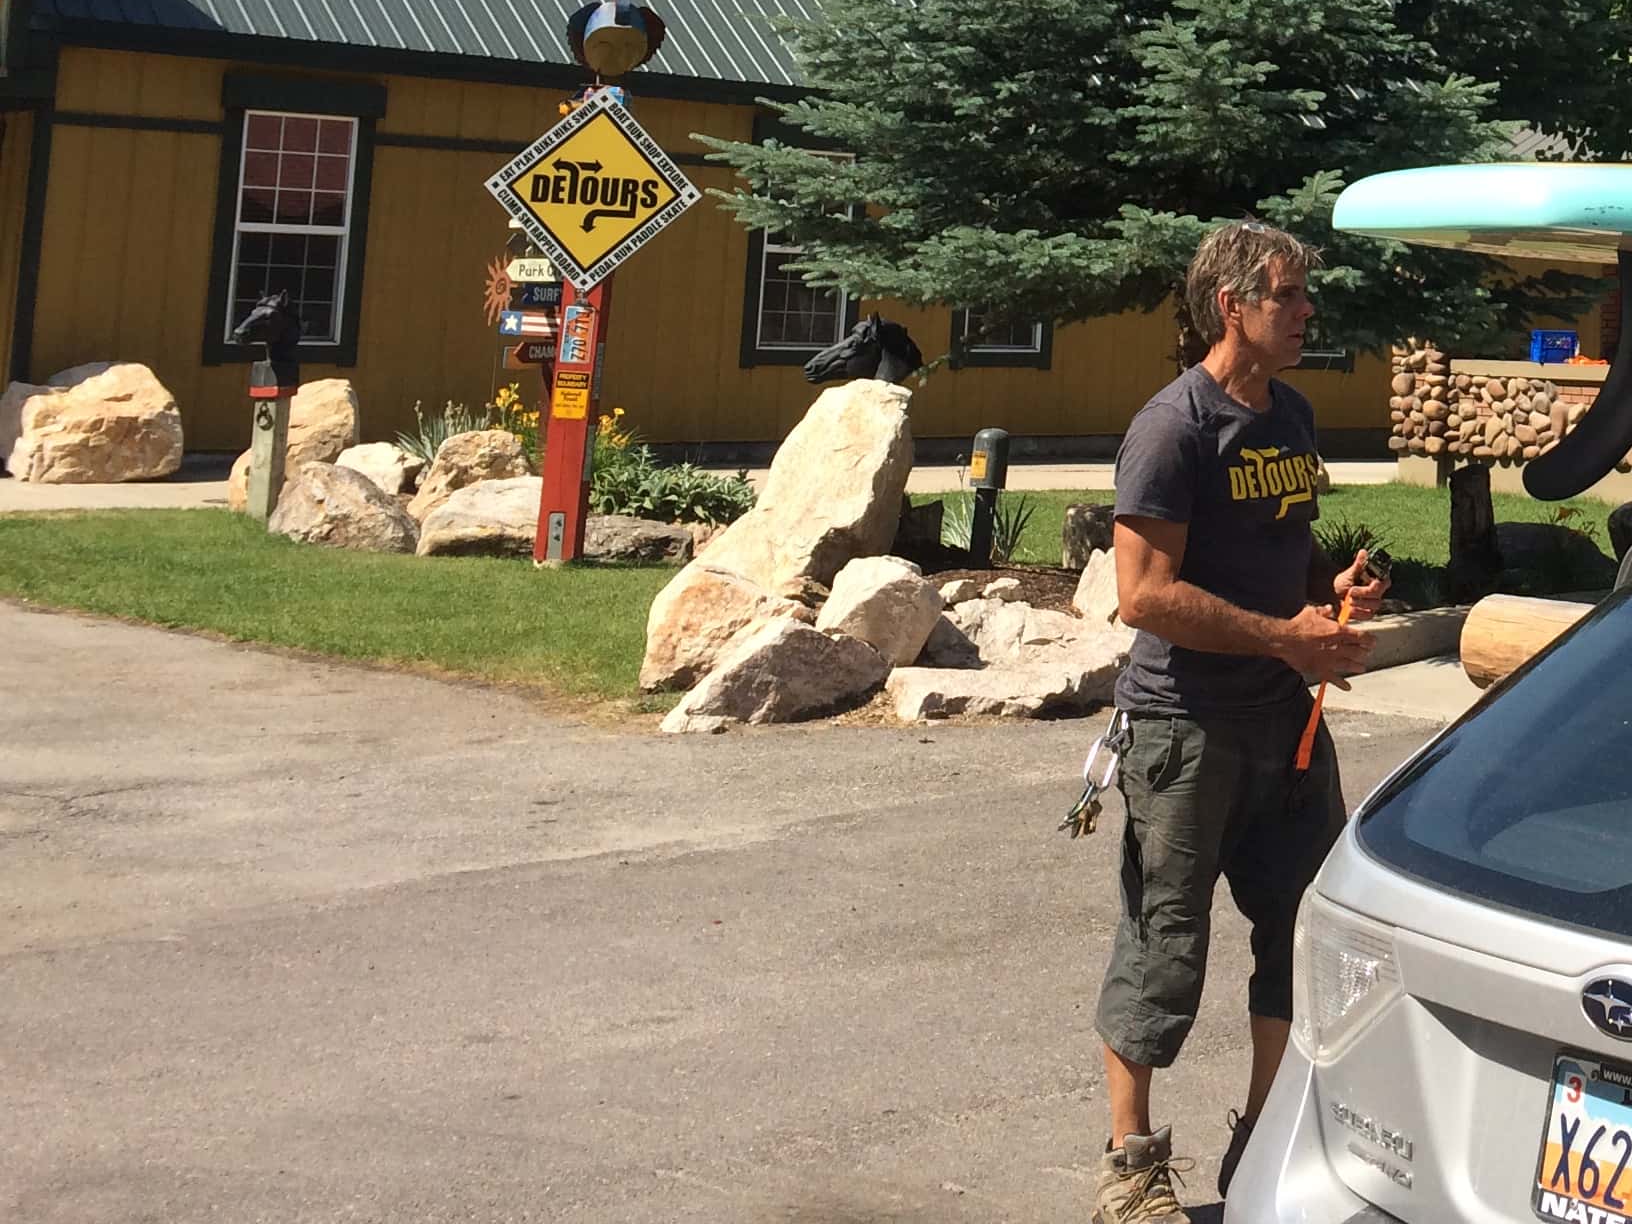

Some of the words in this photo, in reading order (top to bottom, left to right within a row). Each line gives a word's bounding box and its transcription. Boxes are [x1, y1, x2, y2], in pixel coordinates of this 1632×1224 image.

[499, 164, 516, 182] EAT
[513, 150, 536, 170] PLAY
[533, 137, 555, 155] BIKE
[552, 120, 574, 139] HIKE
[572, 100, 599, 123] SWIM
[608, 103, 629, 124] BOAT
[625, 122, 644, 140] RUN
[640, 137, 662, 159] SHOP
[657, 159, 688, 191] EXPLORE
[530, 157, 659, 208] DETOURS
[497, 189, 522, 216] CLIMB
[518, 212, 535, 229] SKI
[529, 226, 558, 255] RAPPEL
[554, 251, 581, 280] BOARD
[518, 263, 544, 277] Park
[589, 258, 616, 282] PEDAL
[613, 243, 633, 262] RUN
[630, 219, 662, 247] PADDLE
[660, 199, 688, 224] SKATE
[1228, 447, 1317, 501] DETOURS
[1567, 1077, 1582, 1103] 3
[1551, 1113, 1632, 1210] X62
